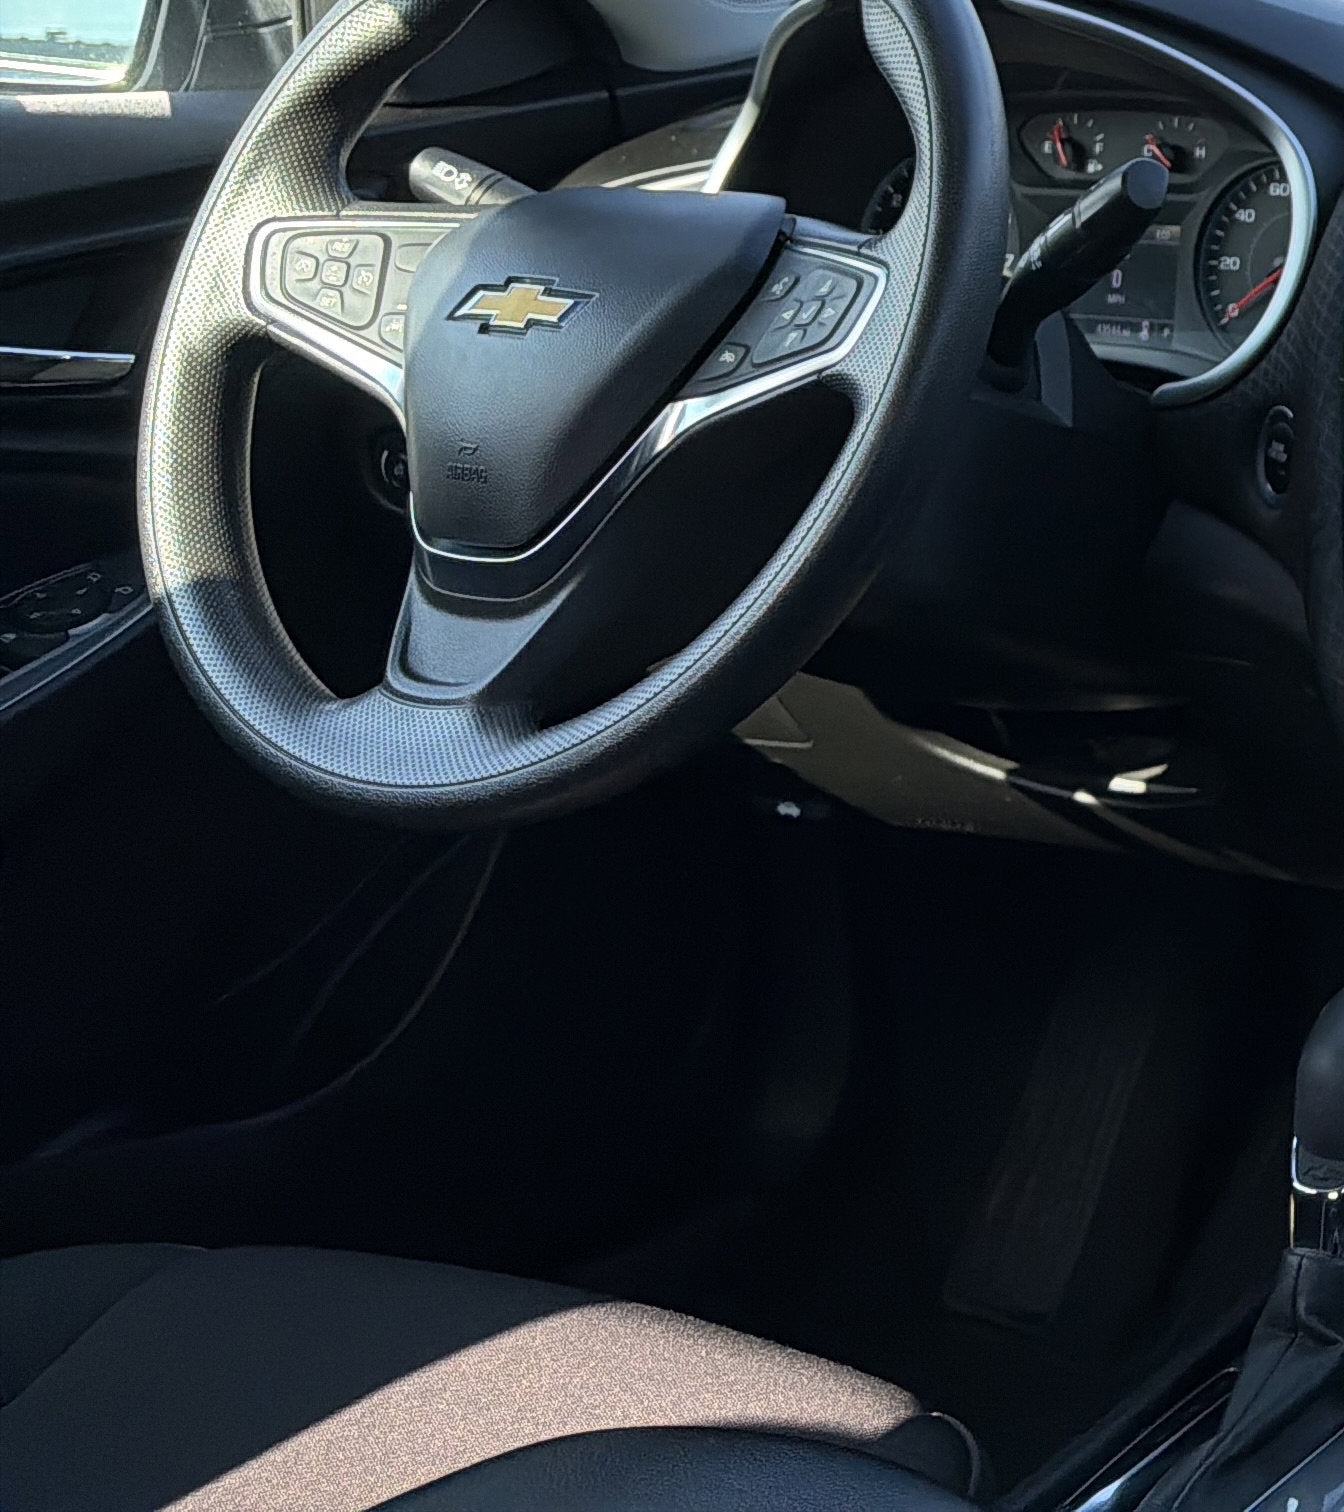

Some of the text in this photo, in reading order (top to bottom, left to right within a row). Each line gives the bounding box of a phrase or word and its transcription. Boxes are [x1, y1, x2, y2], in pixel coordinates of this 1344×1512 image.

[1095, 142, 1104, 155] F
[1143, 143, 1152, 157] C
[1195, 145, 1206, 158] H
[1269, 183, 1290, 197] 60
[1235, 208, 1256, 223] 40
[1219, 256, 1240, 271] 20
[1111, 269, 1122, 288] 0
